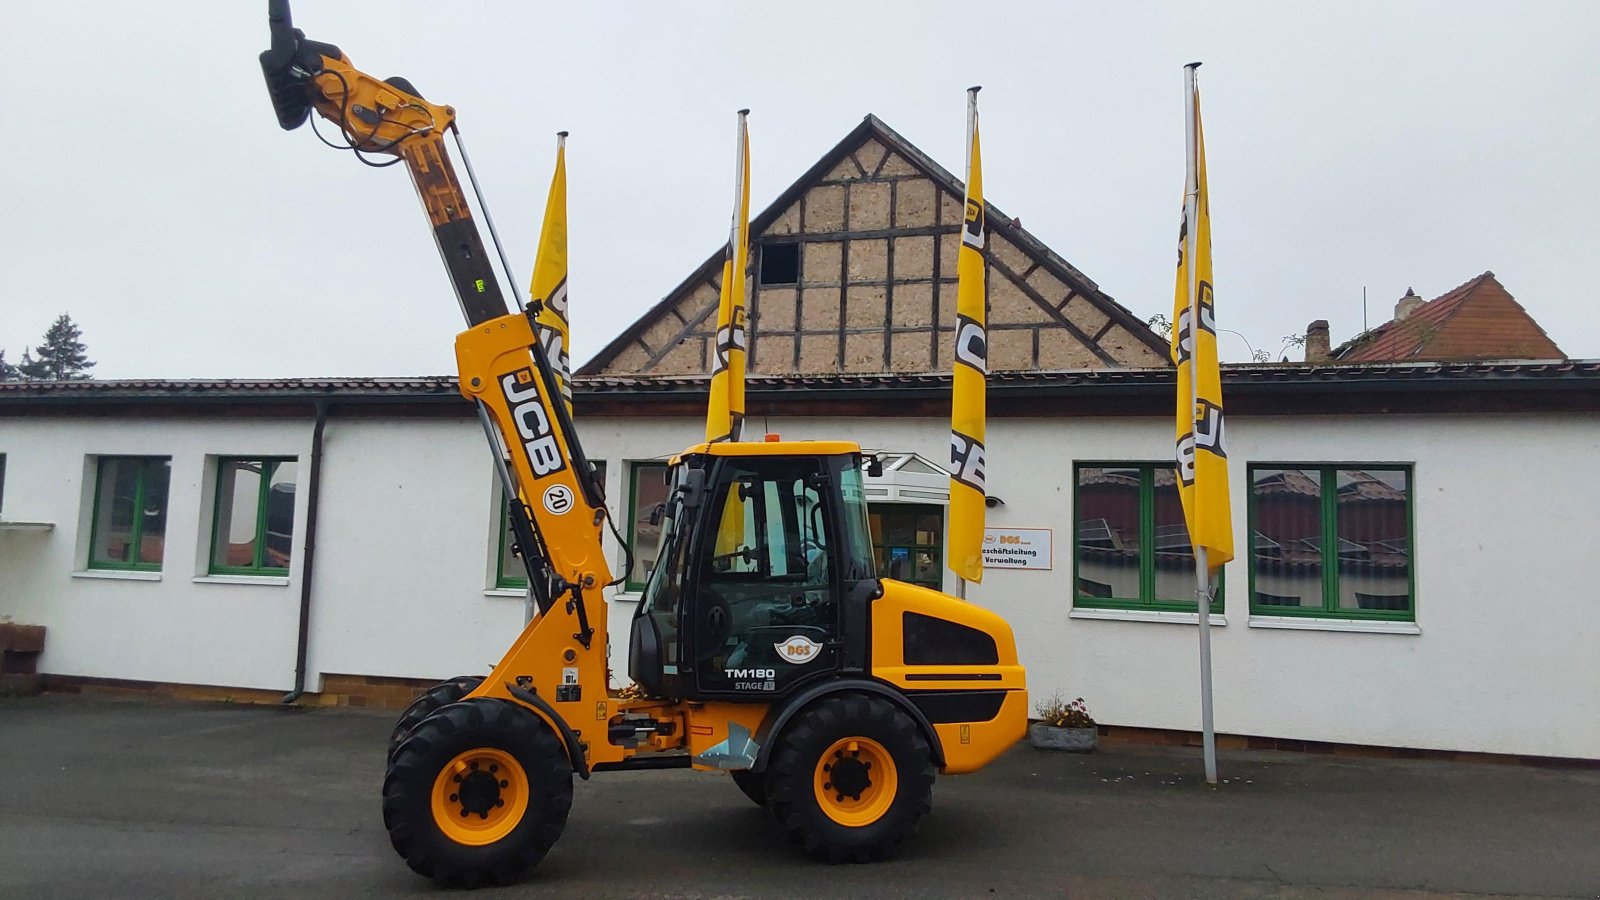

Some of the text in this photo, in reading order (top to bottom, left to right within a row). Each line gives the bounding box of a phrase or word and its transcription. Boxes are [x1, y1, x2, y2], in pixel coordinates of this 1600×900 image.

[502, 374, 562, 477] JCB
[951, 433, 985, 492] CB
[548, 489, 568, 510] 20
[982, 548, 1037, 557] eschäftsleitung
[985, 557, 1027, 566] Verwaltung
[725, 669, 775, 679] TM180
[735, 682, 763, 690] STAGE
